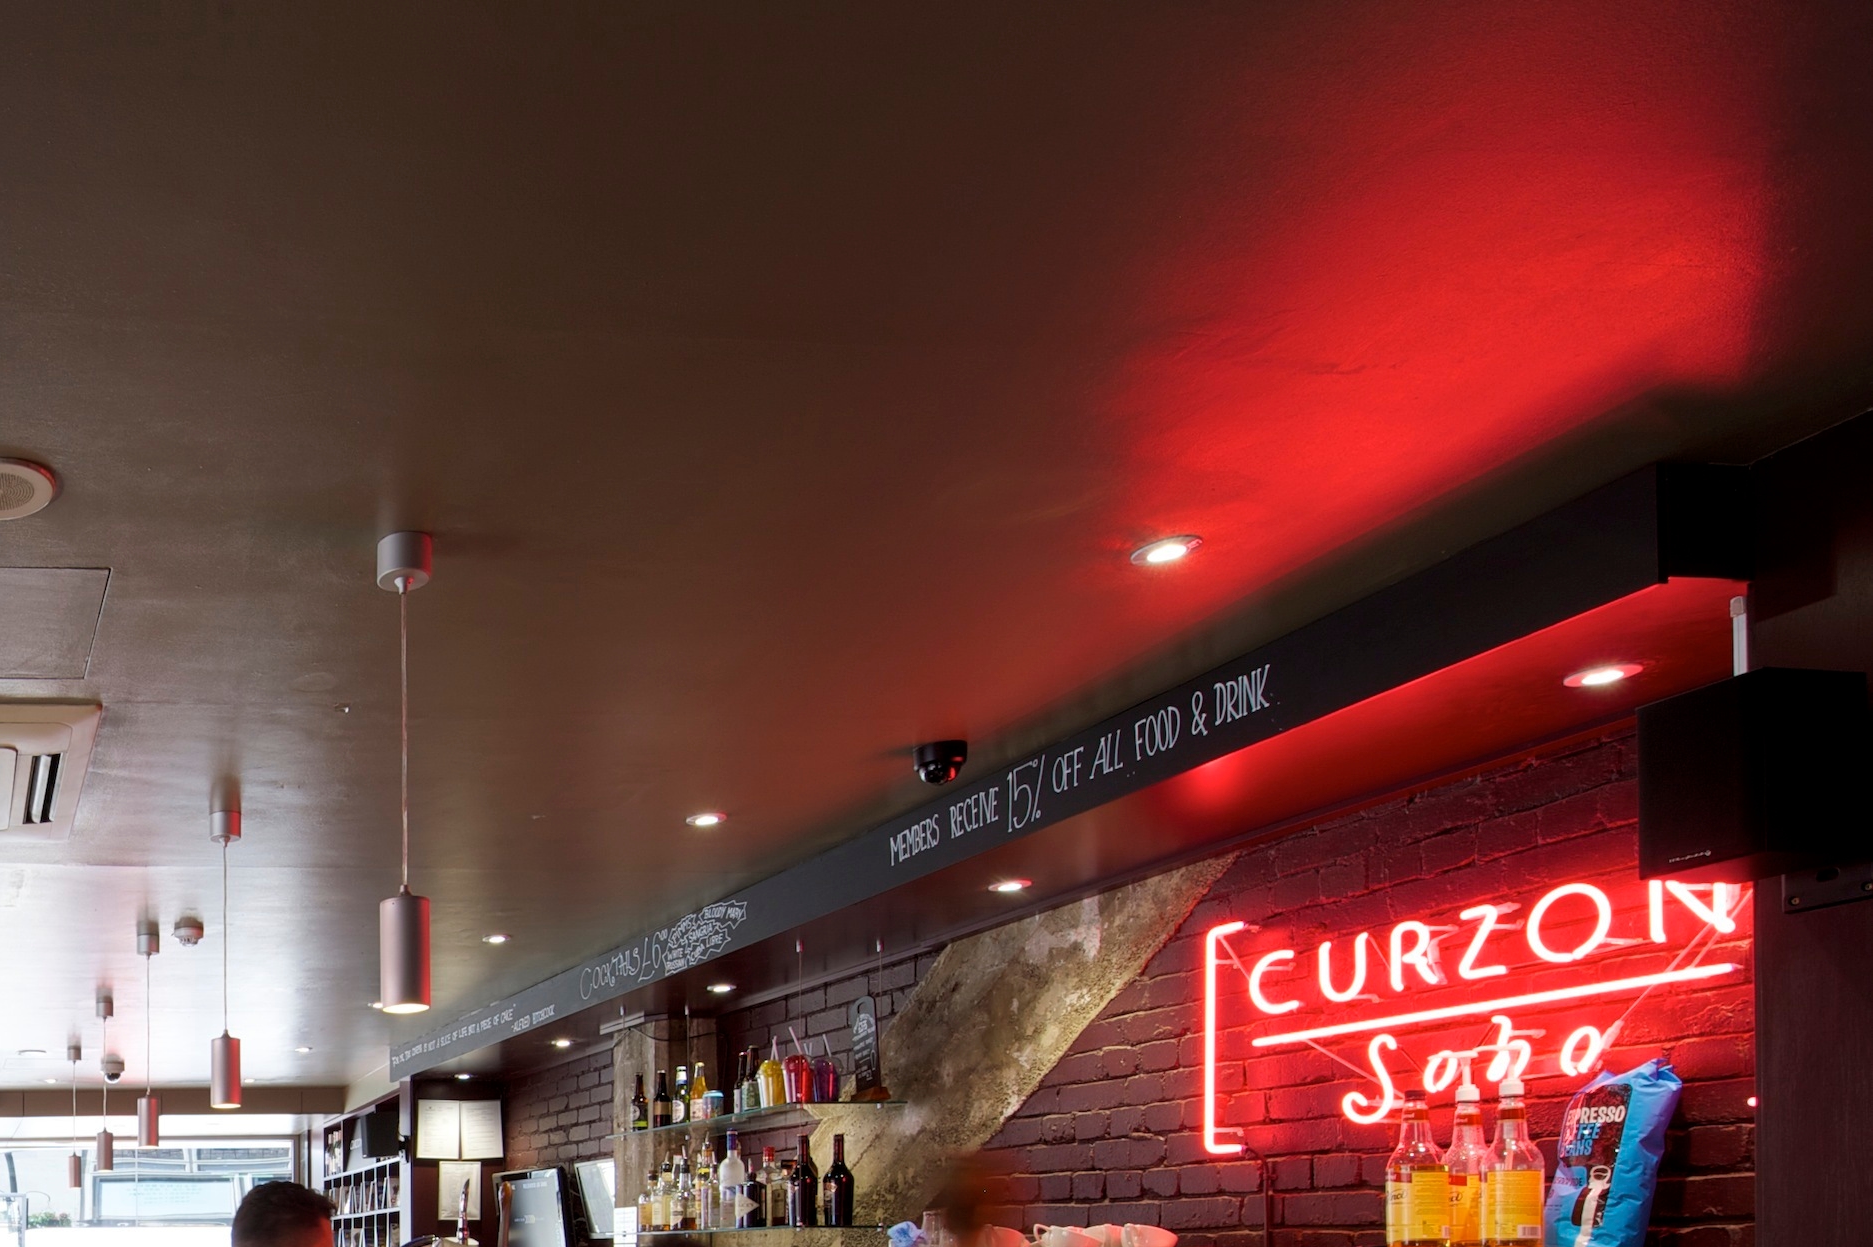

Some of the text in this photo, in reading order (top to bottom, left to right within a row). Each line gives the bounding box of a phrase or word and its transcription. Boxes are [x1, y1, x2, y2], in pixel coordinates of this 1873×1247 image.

[889, 663, 1271, 868] MEMBERS RECEIVE 15% OFF ALL FOOD & DRINK
[688, 923, 713, 943] SANGRIA
[704, 906, 744, 920] BLOODY MARY
[579, 947, 640, 1000] COCKTAILS
[1248, 880, 1737, 1015] CURZON
[1341, 1015, 1610, 1125] Soho
[1566, 1105, 1627, 1125] ESPRESSO
